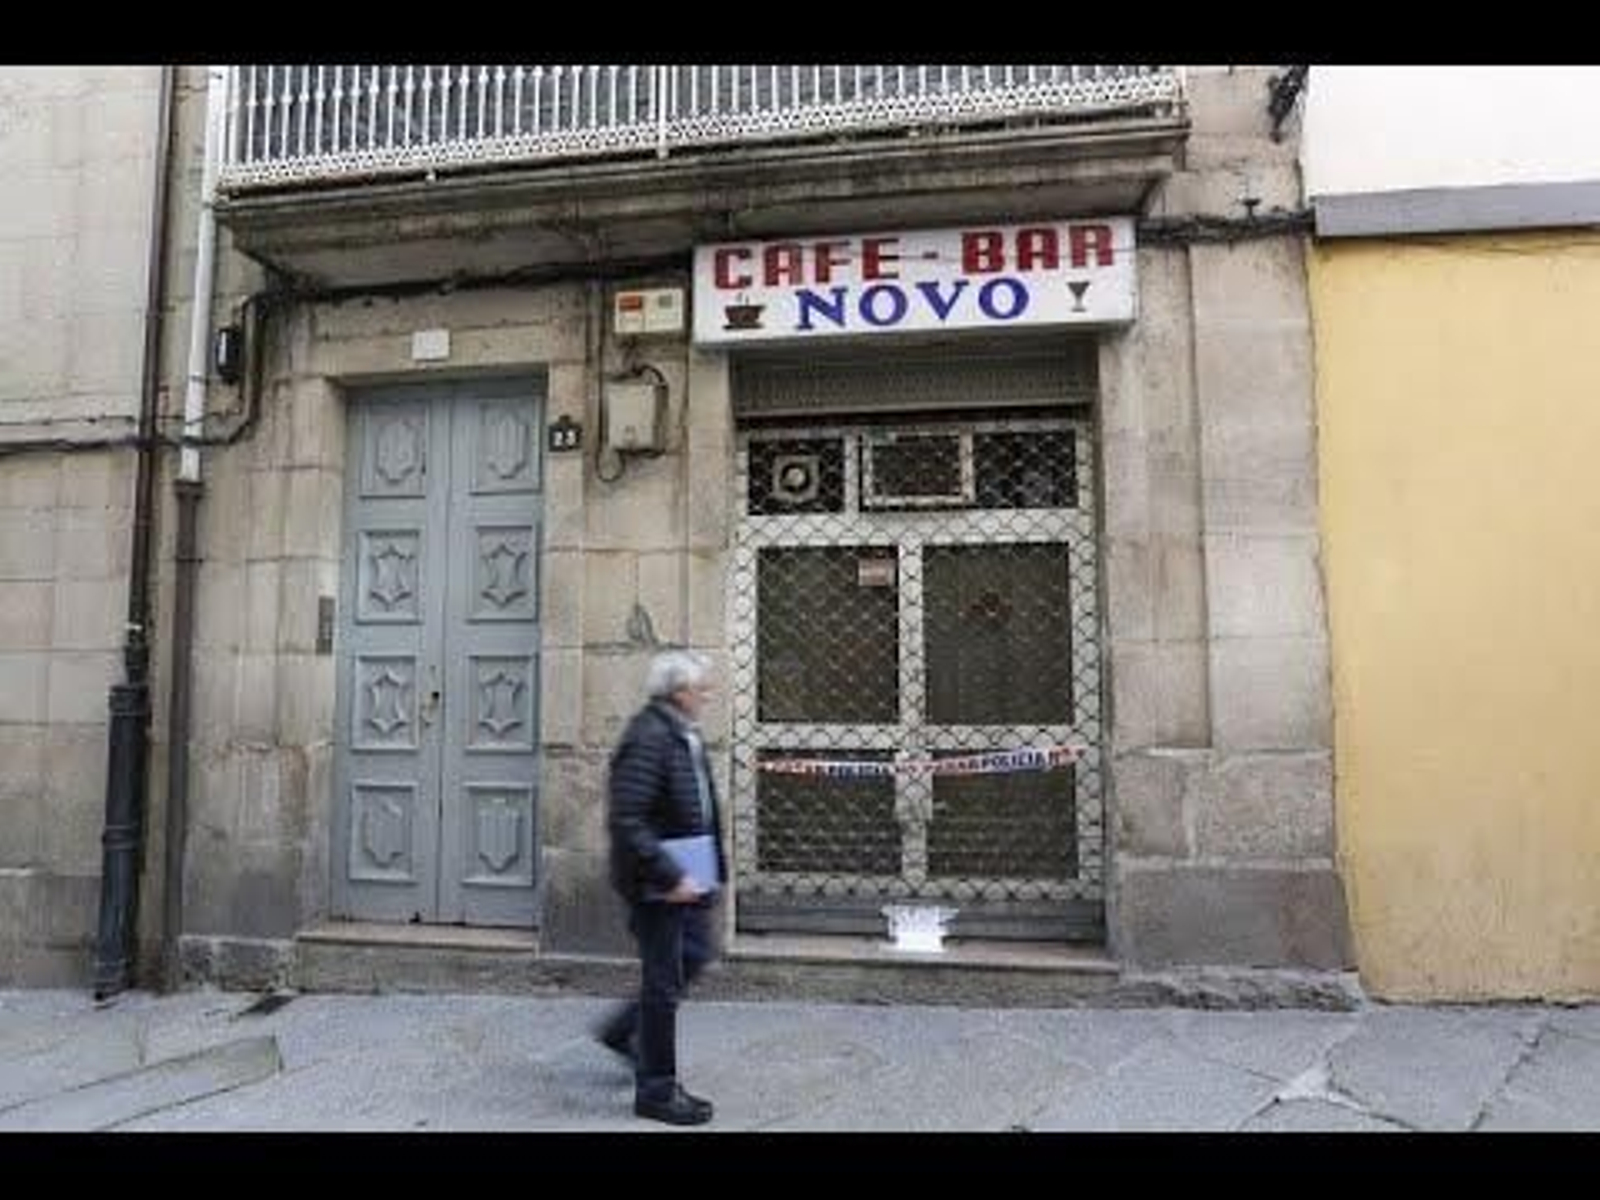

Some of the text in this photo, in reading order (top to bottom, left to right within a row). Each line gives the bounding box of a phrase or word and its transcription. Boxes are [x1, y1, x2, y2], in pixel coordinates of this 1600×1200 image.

[714, 238, 900, 290] CAFE
[961, 225, 1115, 274] BAR
[794, 277, 1030, 330] NOVO
[981, 751, 1046, 769] POLICIA
